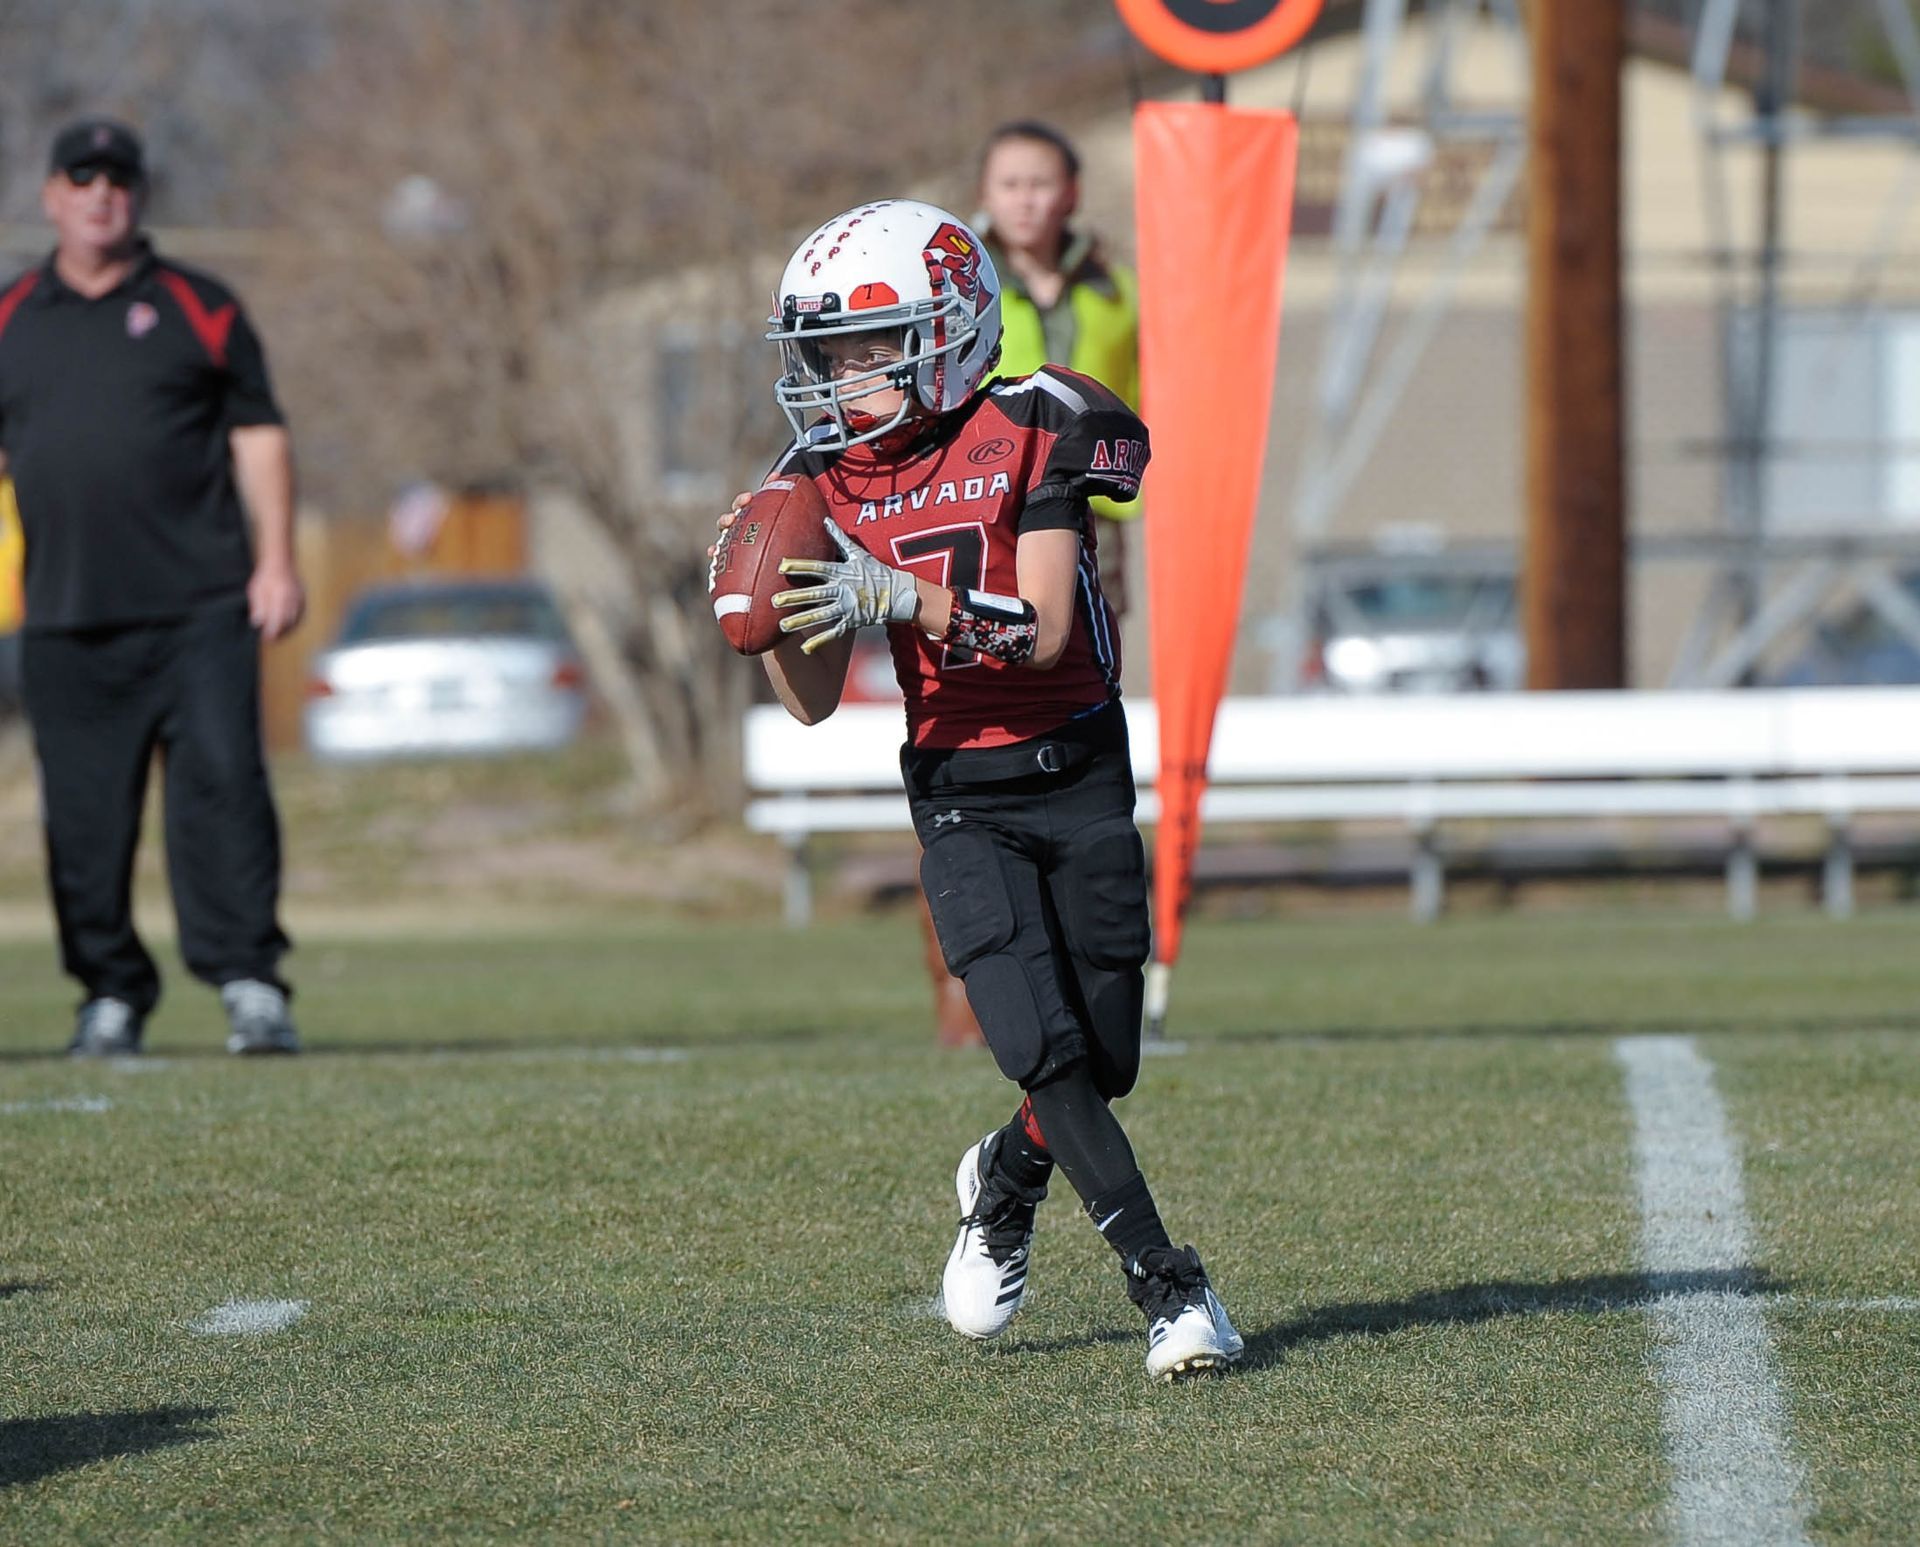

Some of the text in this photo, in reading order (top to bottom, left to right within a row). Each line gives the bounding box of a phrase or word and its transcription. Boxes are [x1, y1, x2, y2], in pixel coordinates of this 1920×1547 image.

[863, 284, 872, 300] 7
[855, 471, 1010, 525] ARVADA
[890, 521, 988, 670] 7
